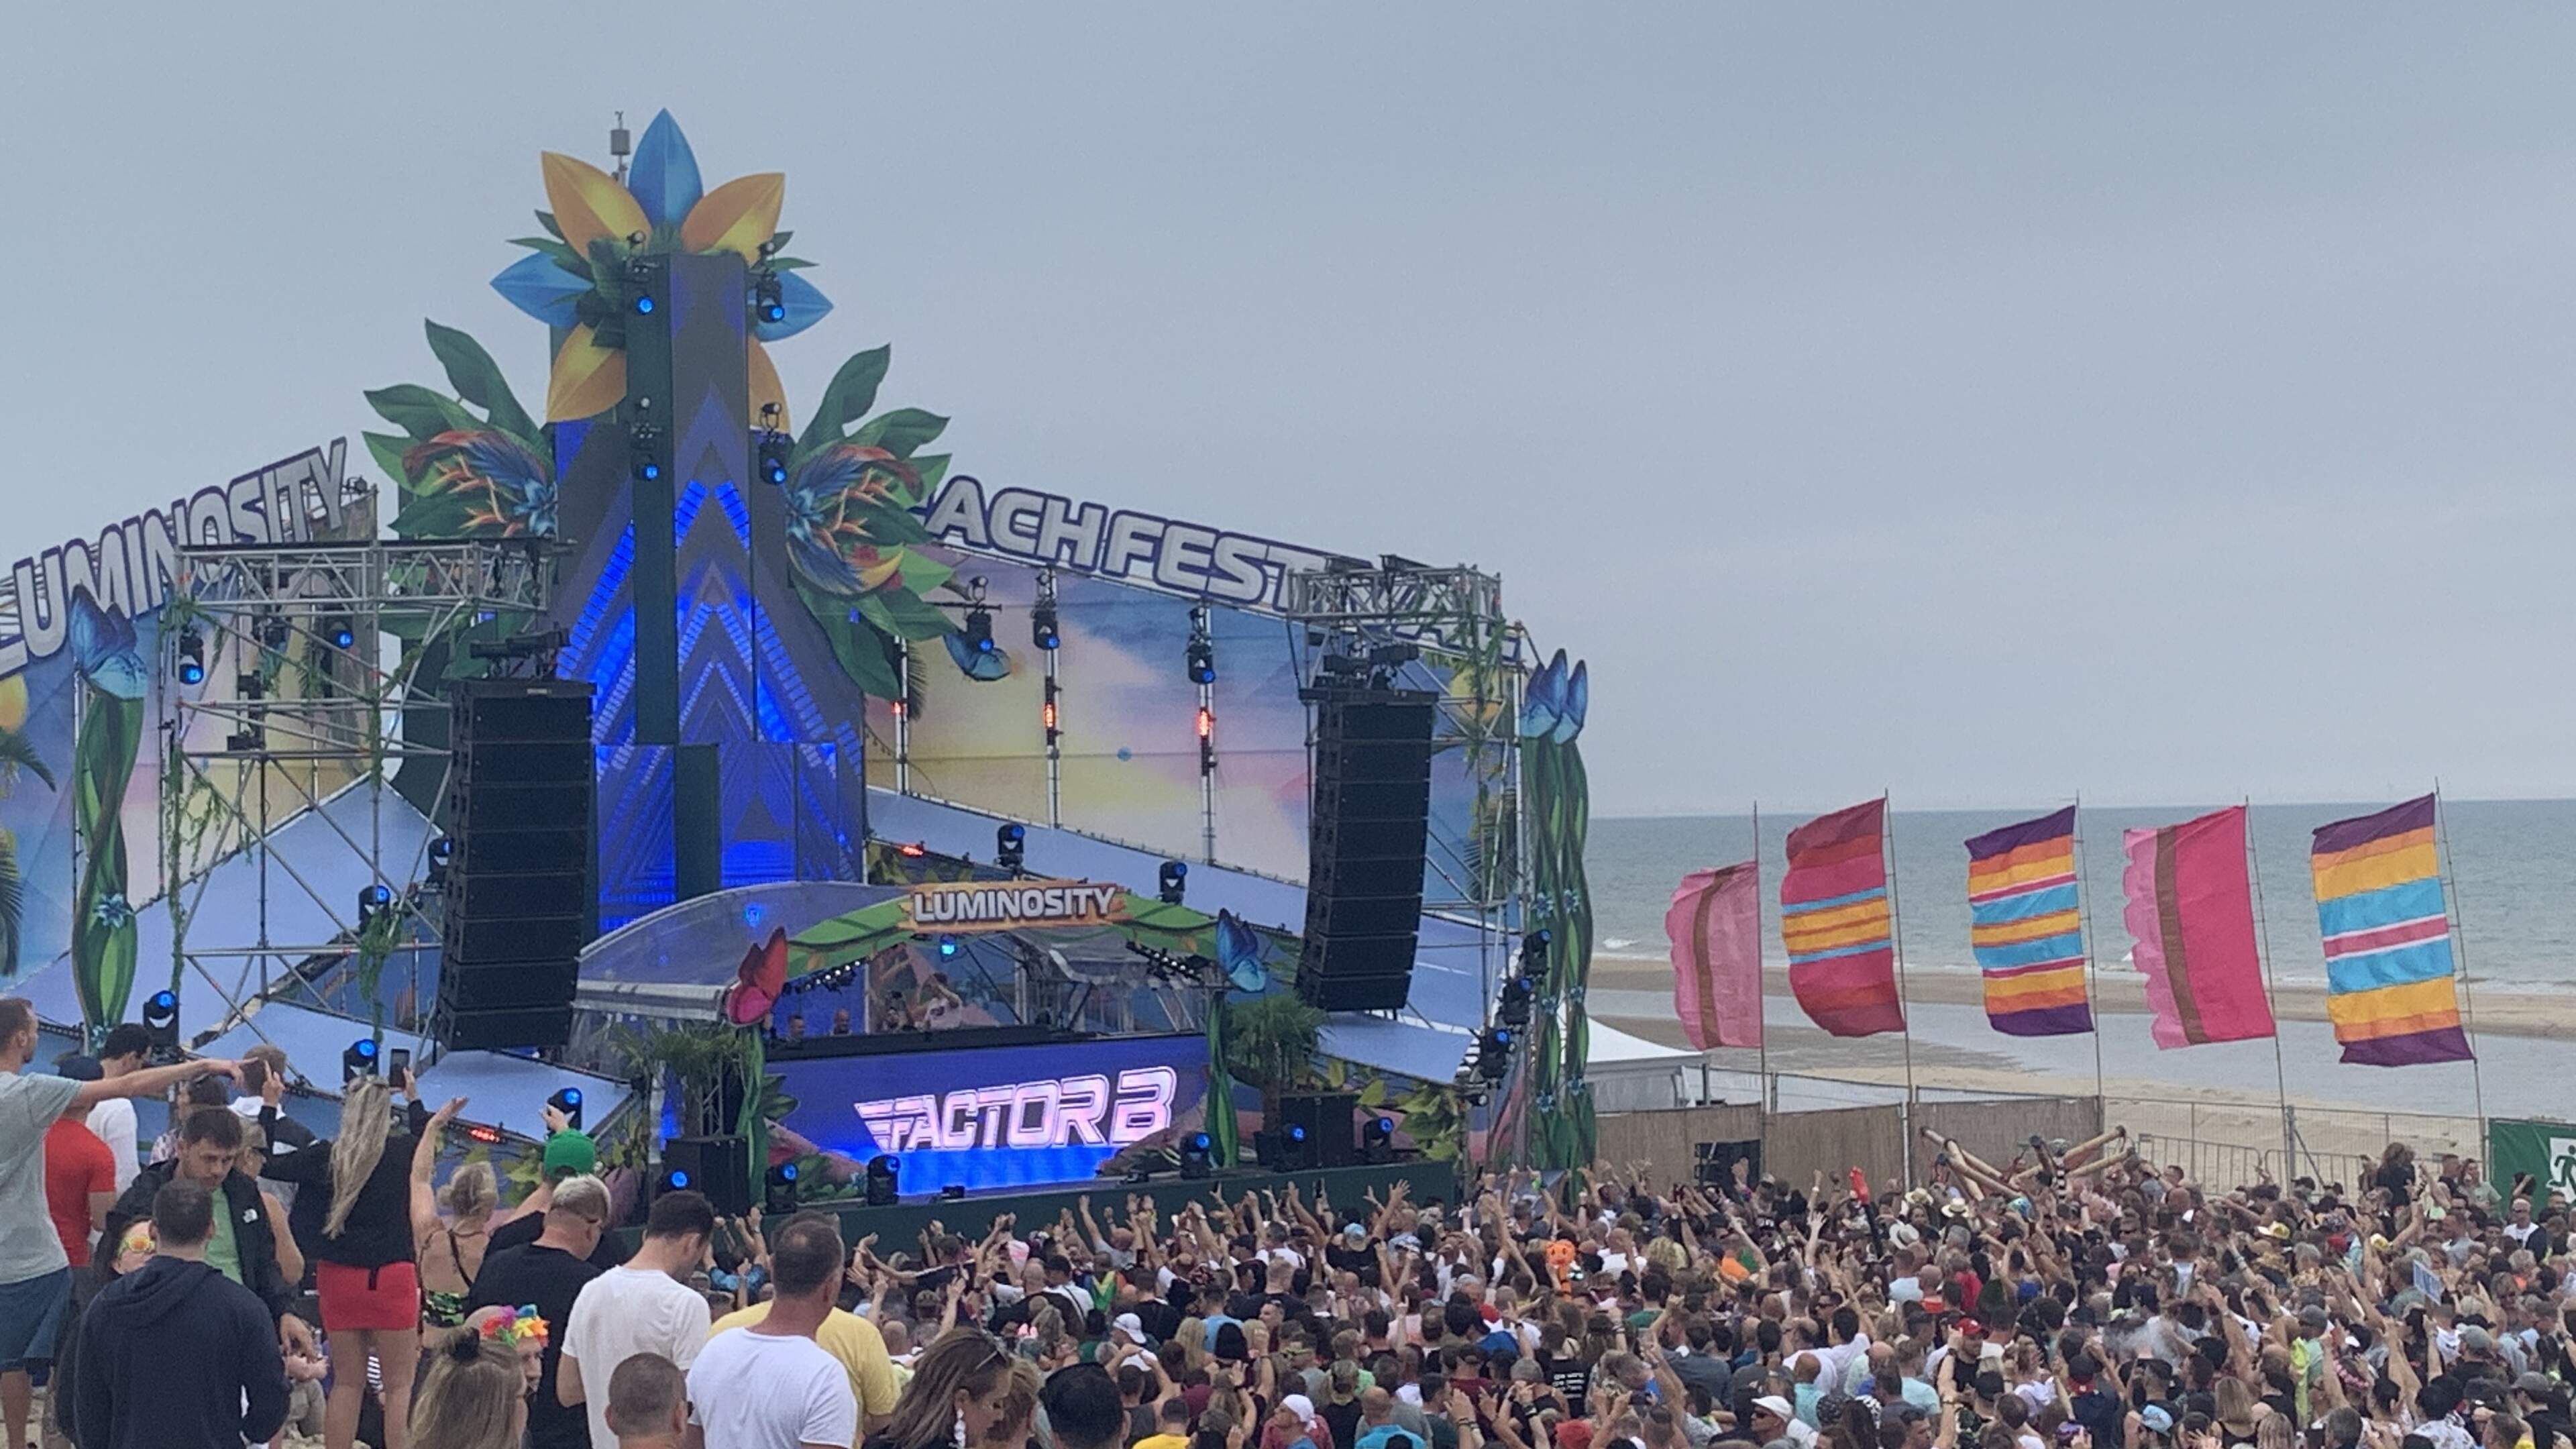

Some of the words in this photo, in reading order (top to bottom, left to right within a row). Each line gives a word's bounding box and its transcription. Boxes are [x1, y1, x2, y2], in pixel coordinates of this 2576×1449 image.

[914, 886, 1117, 922] LUMINOSITY
[853, 1074, 1108, 1153] FACTOR
[1109, 1065, 1177, 1148] B
